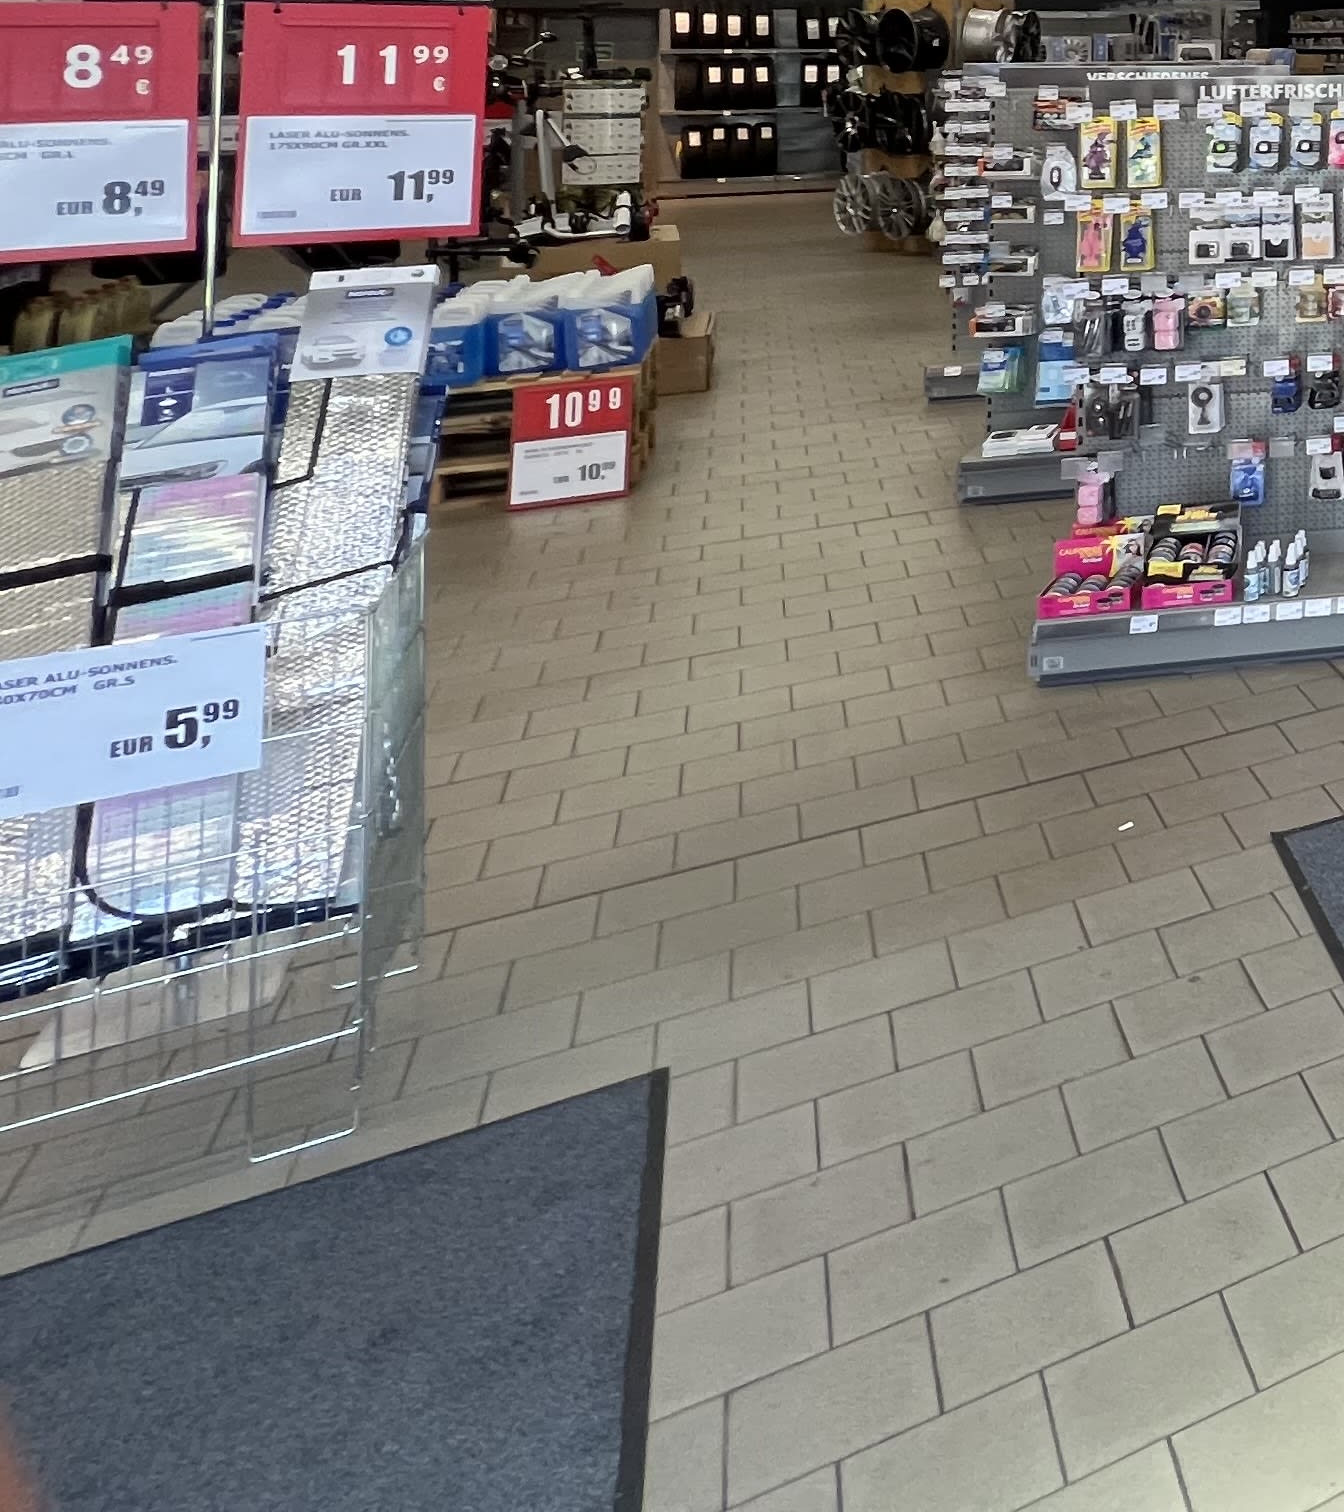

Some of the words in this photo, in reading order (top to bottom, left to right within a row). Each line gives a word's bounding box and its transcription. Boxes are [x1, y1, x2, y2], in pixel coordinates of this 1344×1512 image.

[329, 187, 362, 202] EUR
[56, 200, 94, 216] EUR
[44, 654, 179, 685] ALU-SONNENS.
[109, 735, 154, 759] EUR
